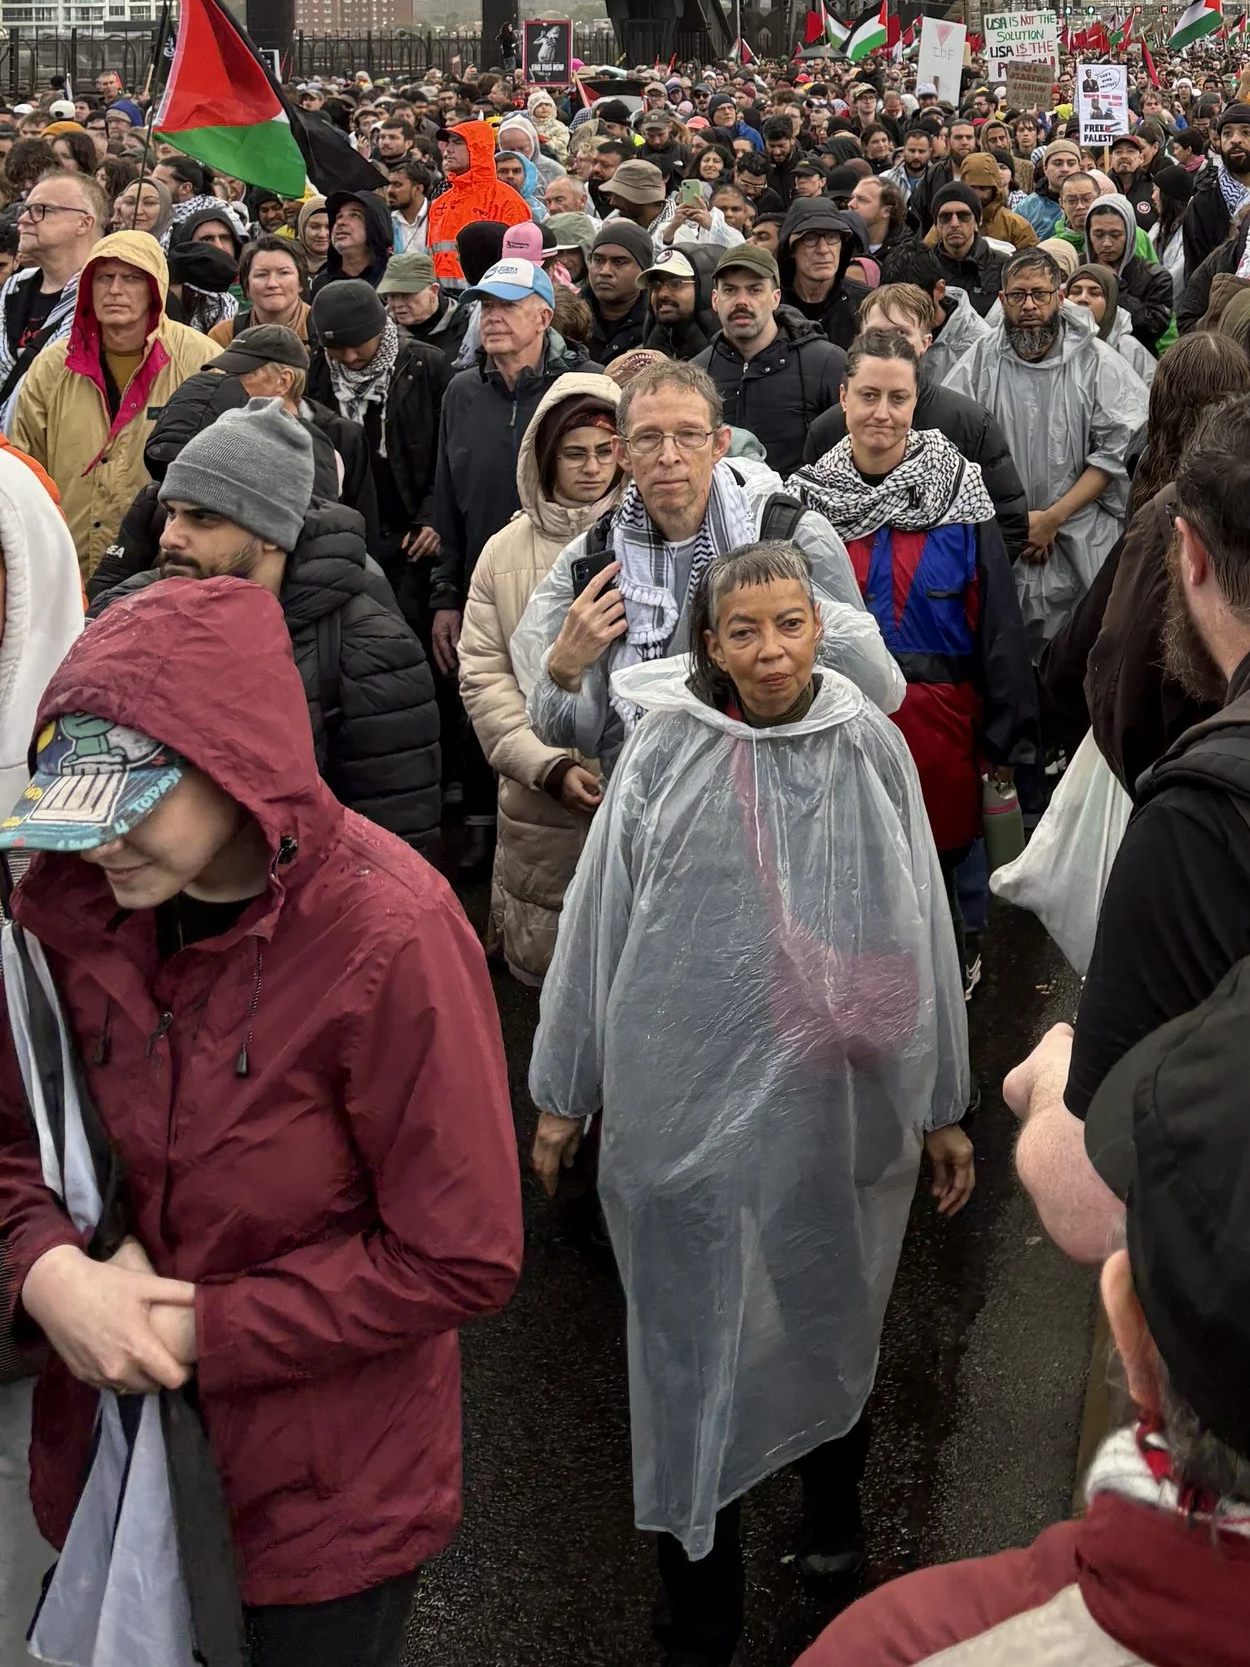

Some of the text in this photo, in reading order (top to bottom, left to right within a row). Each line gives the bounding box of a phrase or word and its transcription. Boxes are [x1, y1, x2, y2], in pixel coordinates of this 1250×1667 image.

[986, 13, 1056, 30] USA IS NOT THE
[997, 29, 1044, 42] SOLUTION
[990, 41, 1054, 58] USA IS THE
[1084, 124, 1105, 132] FREE
